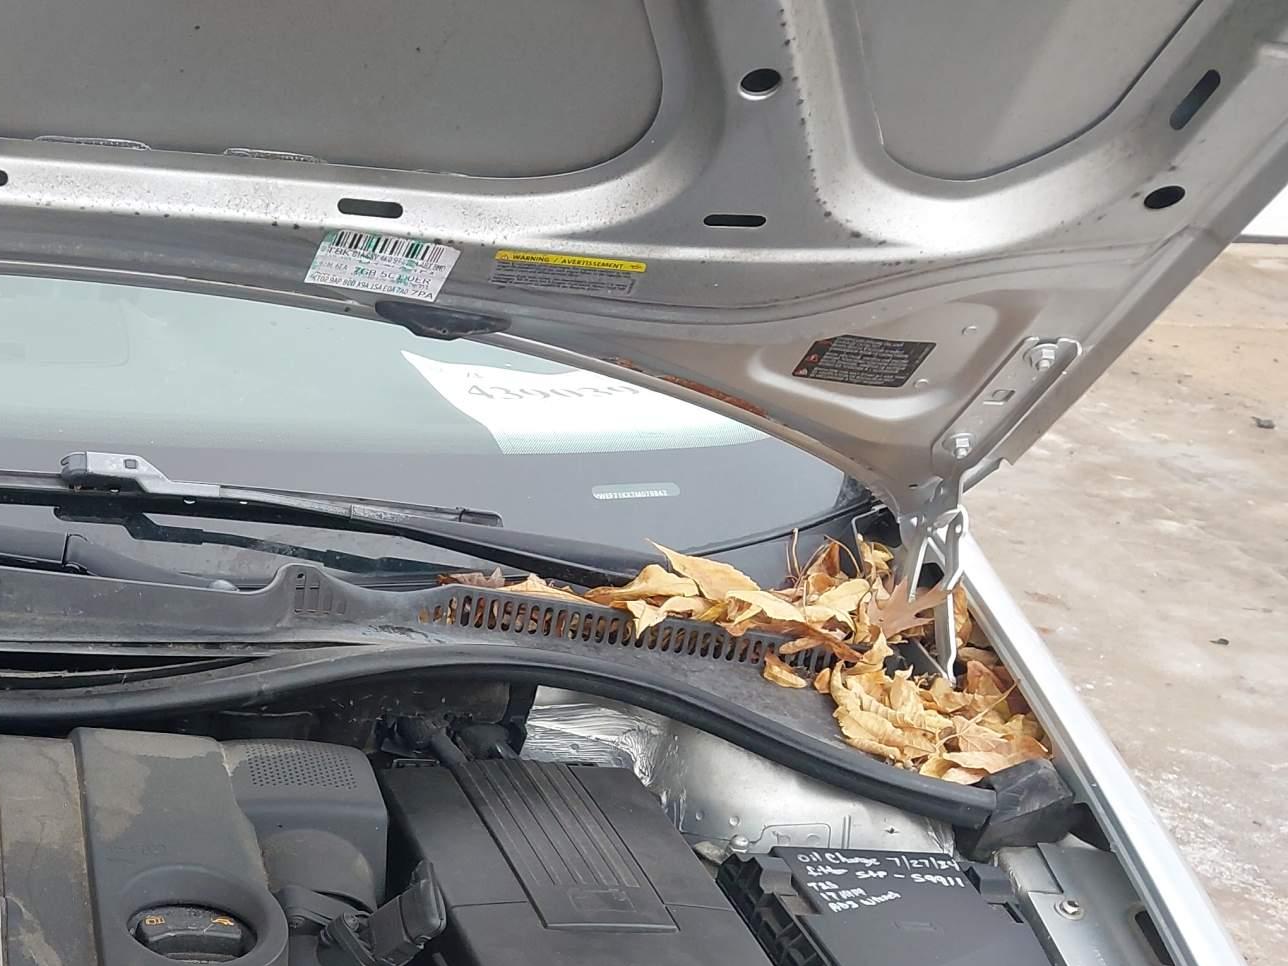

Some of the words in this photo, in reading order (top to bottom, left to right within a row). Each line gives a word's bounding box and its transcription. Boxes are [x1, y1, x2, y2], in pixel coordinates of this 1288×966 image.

[512, 254, 550, 263] WARNING
[562, 257, 624, 270] AVERTISSEMENT
[797, 851, 823, 863] Oil
[824, 852, 881, 867] Change
[885, 854, 961, 872] 7/27/24
